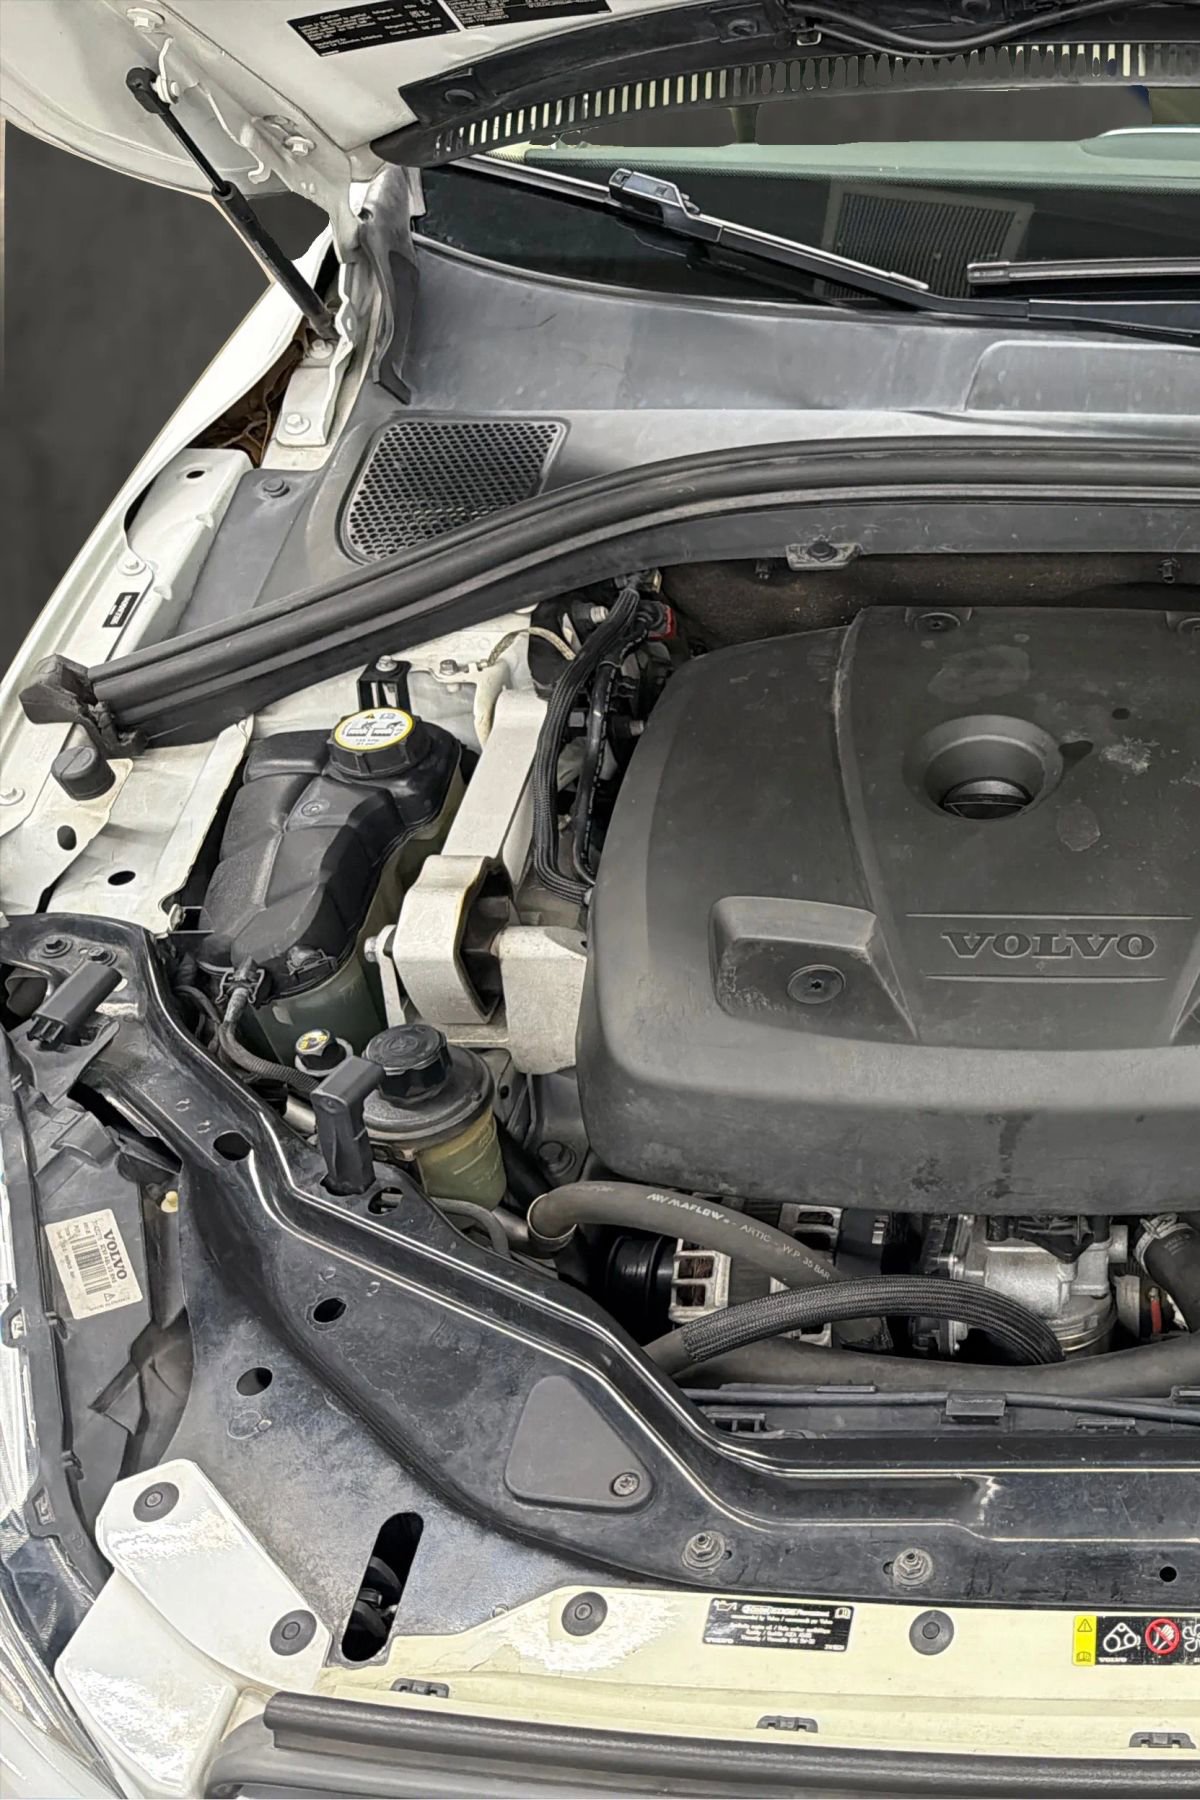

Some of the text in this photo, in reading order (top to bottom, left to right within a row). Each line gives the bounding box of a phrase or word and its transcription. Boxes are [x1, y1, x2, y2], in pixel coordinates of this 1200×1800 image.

[941, 932, 1157, 959] VOLVO
[103, 1229, 128, 1280] VOLVO
[814, 1264, 831, 1280] BAR
